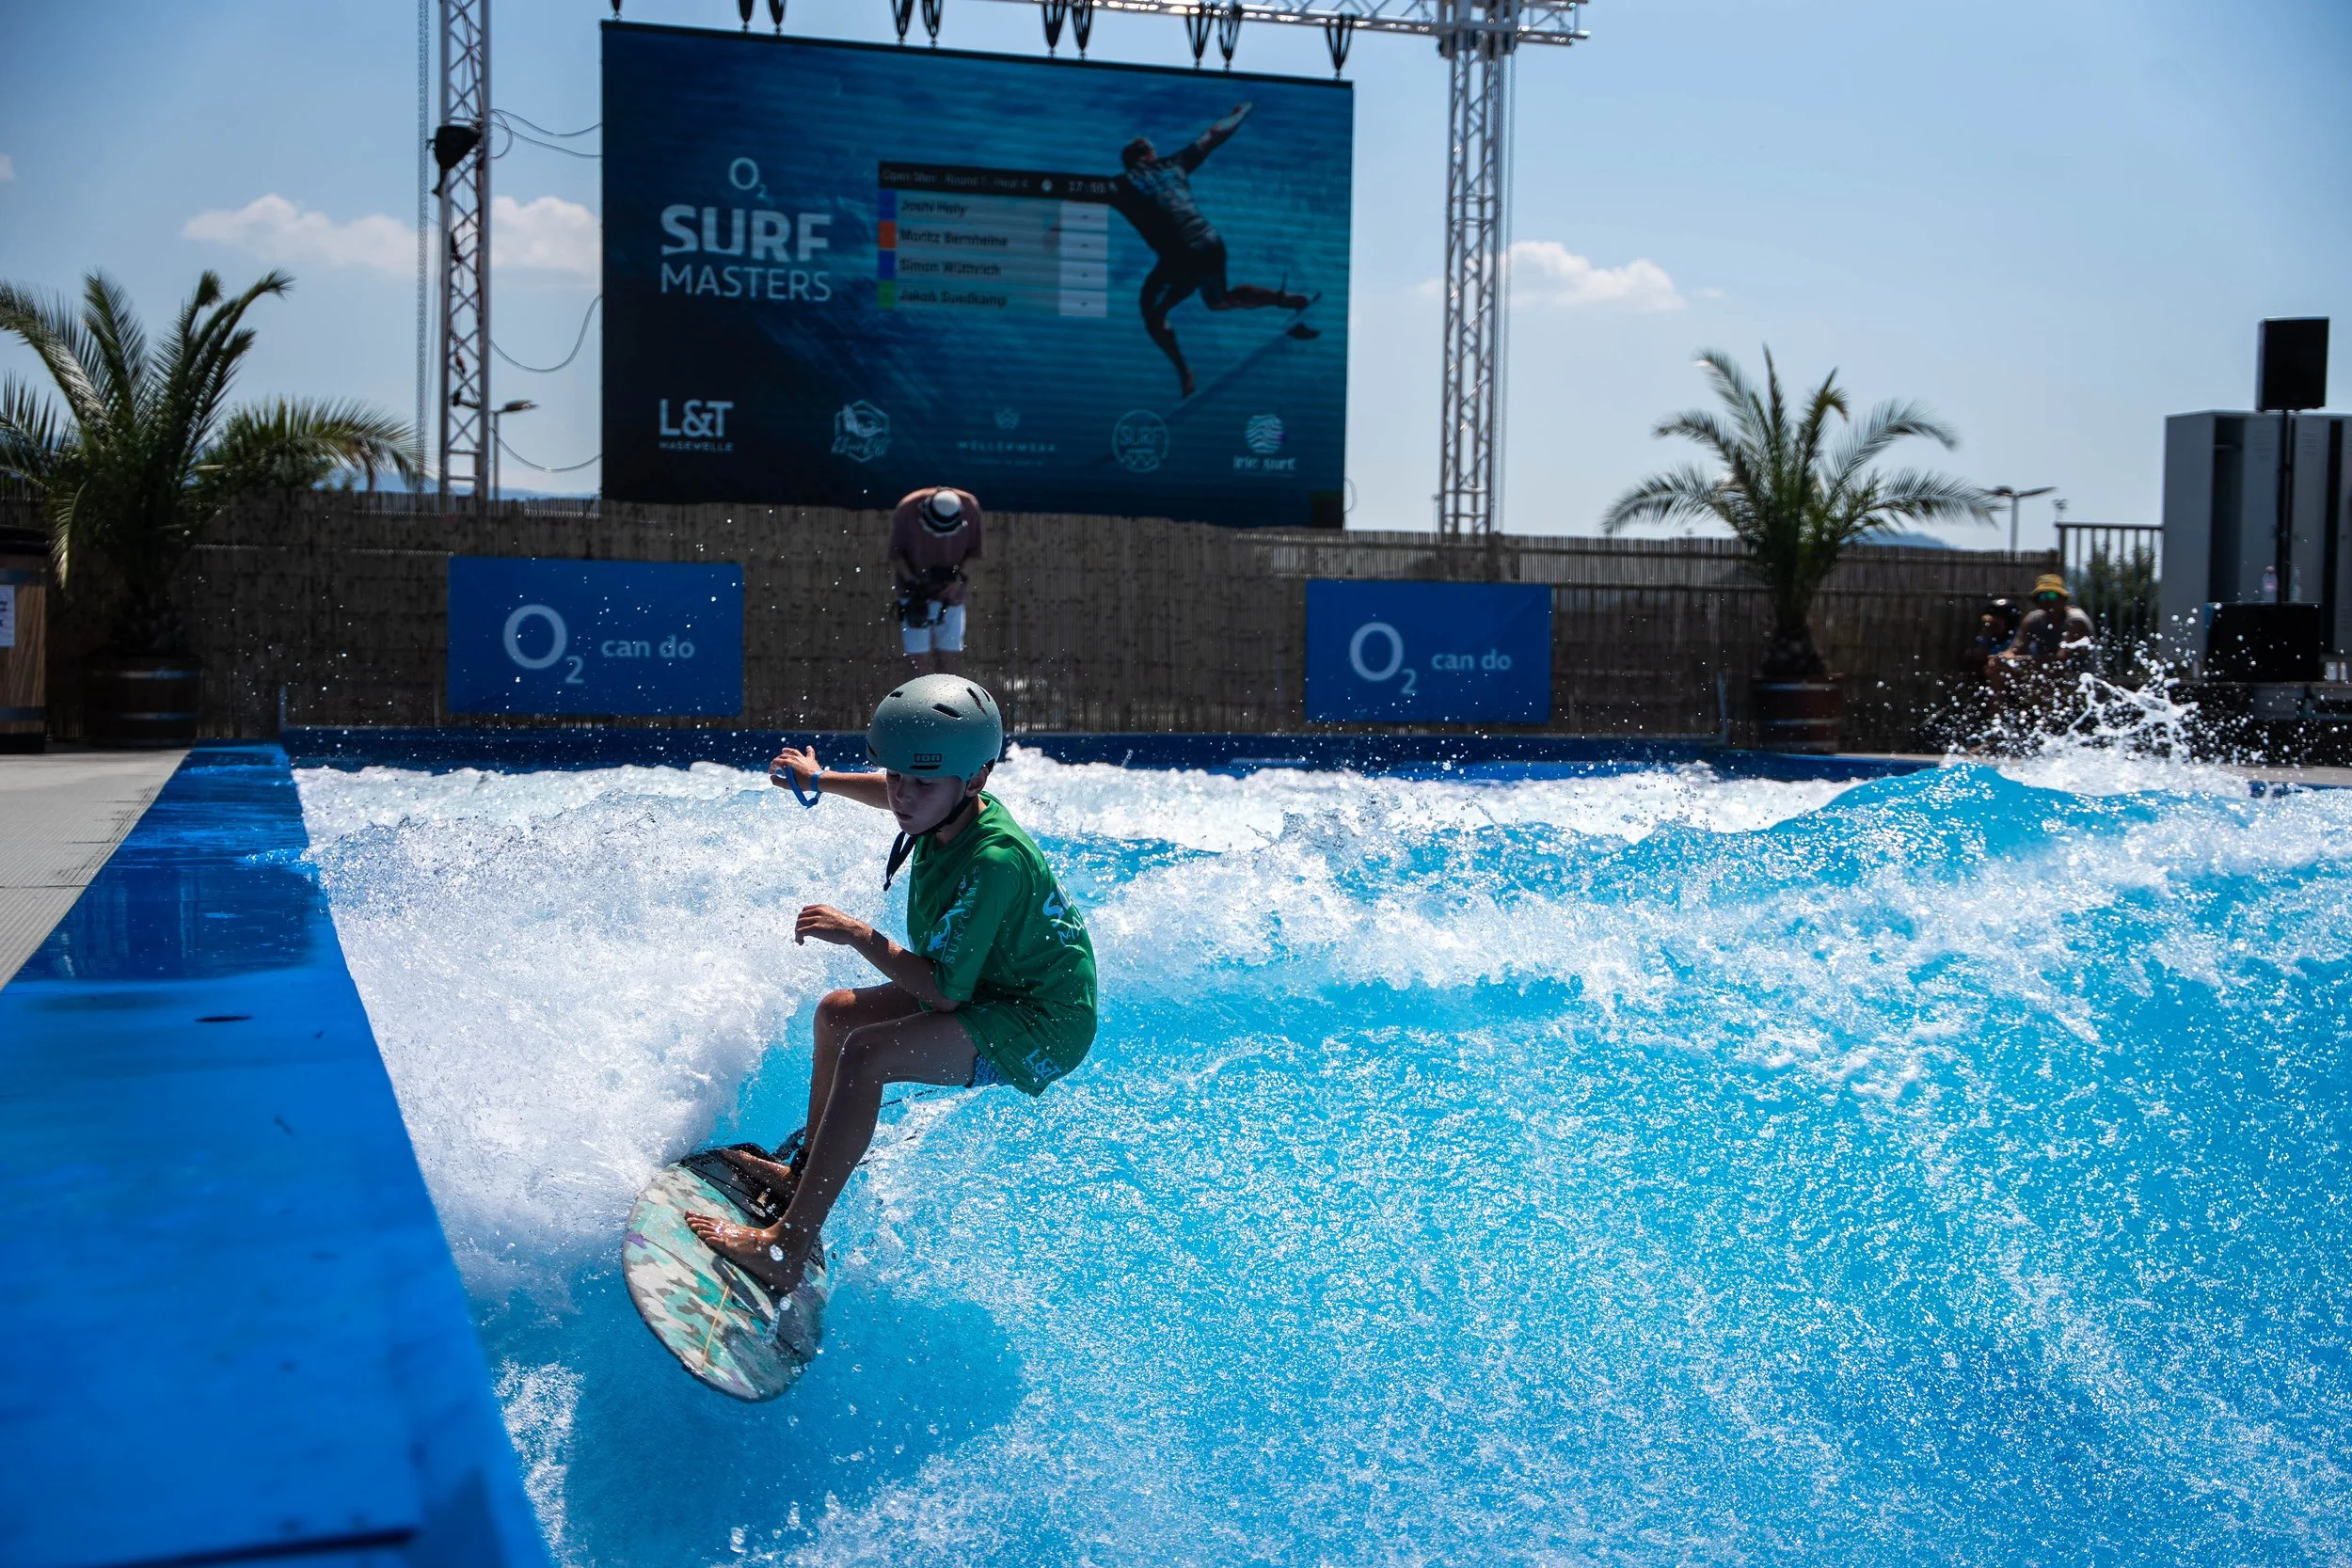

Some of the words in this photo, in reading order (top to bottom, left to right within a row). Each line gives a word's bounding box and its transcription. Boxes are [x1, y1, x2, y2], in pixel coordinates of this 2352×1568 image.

[660, 203, 833, 262] SURF
[899, 229, 941, 244] Moritz
[660, 261, 832, 302] MASTERS
[899, 258, 939, 273] Simon
[899, 288, 937, 303] Jakob
[660, 399, 735, 437] L&T
[503, 604, 584, 684] O2
[601, 640, 650, 657] can
[660, 634, 695, 658] do
[1349, 622, 1418, 695] O2
[1430, 653, 1475, 672] can
[1480, 647, 1514, 672] do
[1025, 1048, 1062, 1080] L&T
